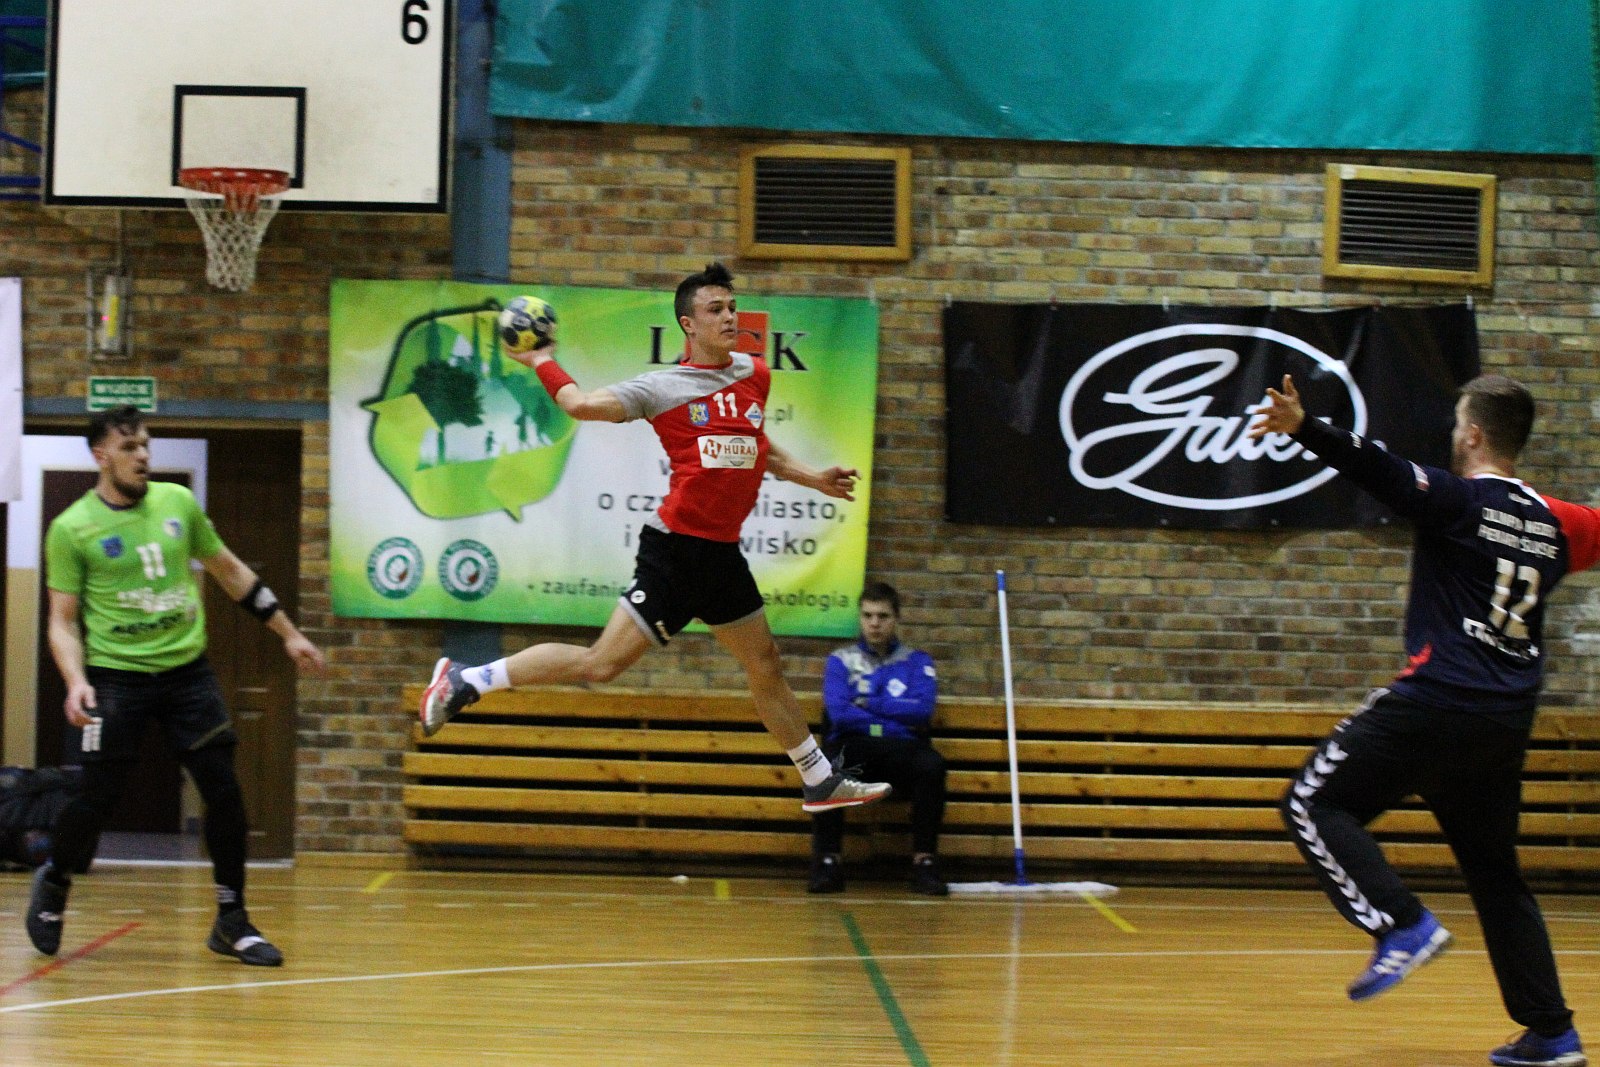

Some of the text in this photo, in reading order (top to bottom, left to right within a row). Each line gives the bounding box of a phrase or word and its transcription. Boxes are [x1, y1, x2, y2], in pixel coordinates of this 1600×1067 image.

[401, 0, 430, 45] 6
[712, 392, 738, 418] 11
[1070, 347, 1333, 490] Gate
[598, 493, 614, 510] o
[625, 524, 631, 547] i
[136, 542, 167, 580] 11
[1488, 557, 1542, 640] 12
